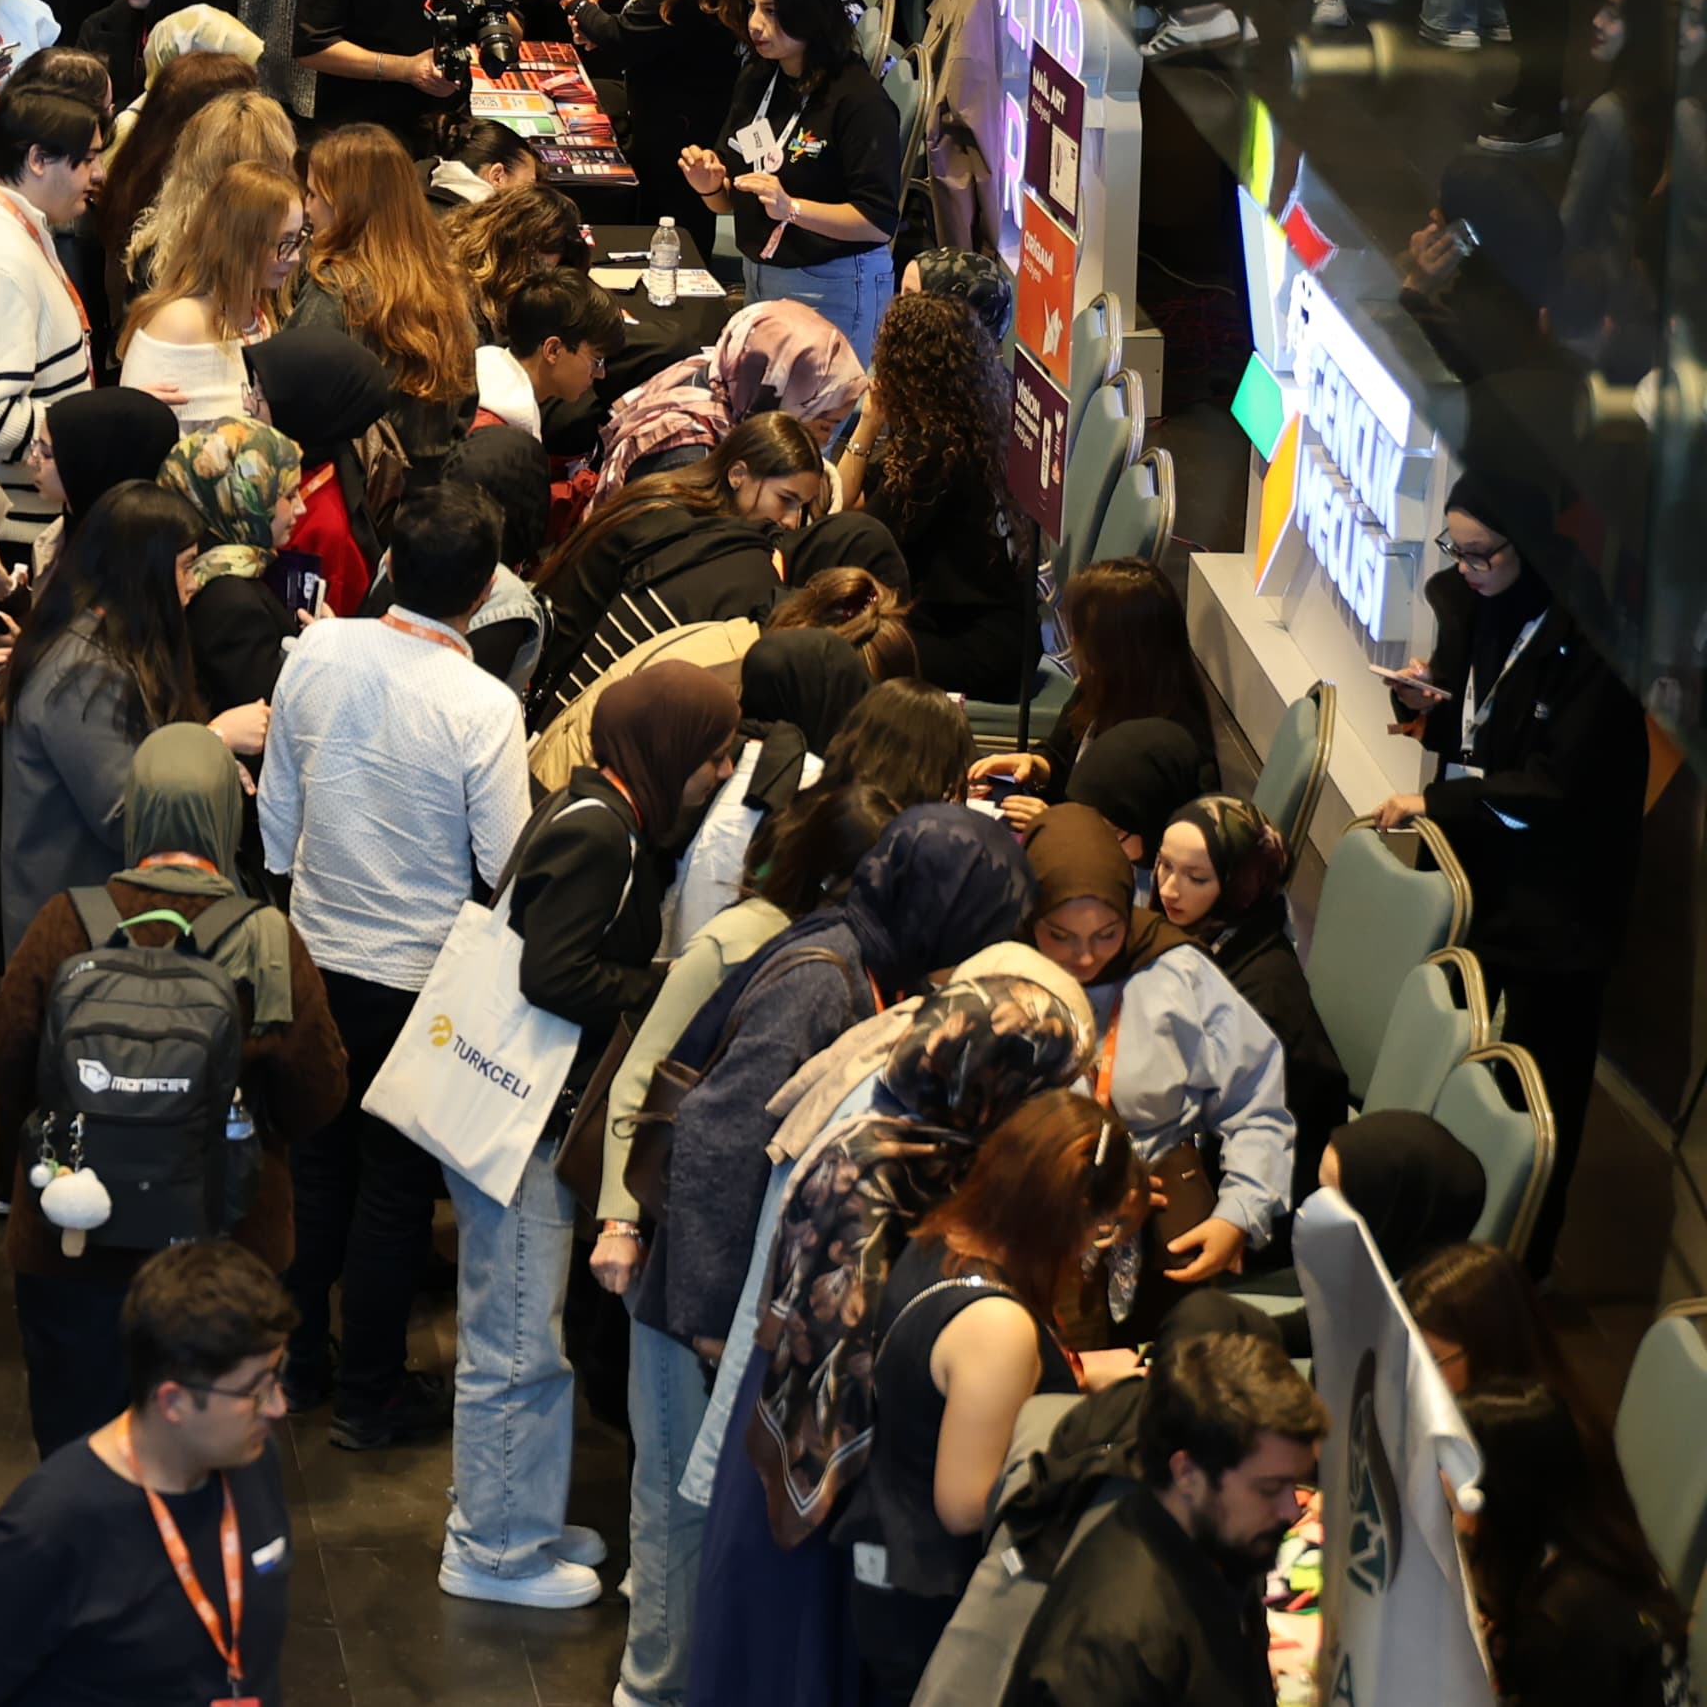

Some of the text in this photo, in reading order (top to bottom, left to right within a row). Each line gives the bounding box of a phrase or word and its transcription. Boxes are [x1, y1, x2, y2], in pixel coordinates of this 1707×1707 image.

[1032, 65, 1066, 115] MAİL ART
[1308, 341, 1405, 542] GENÇLİK
[1296, 443, 1389, 643] MECLİSİ
